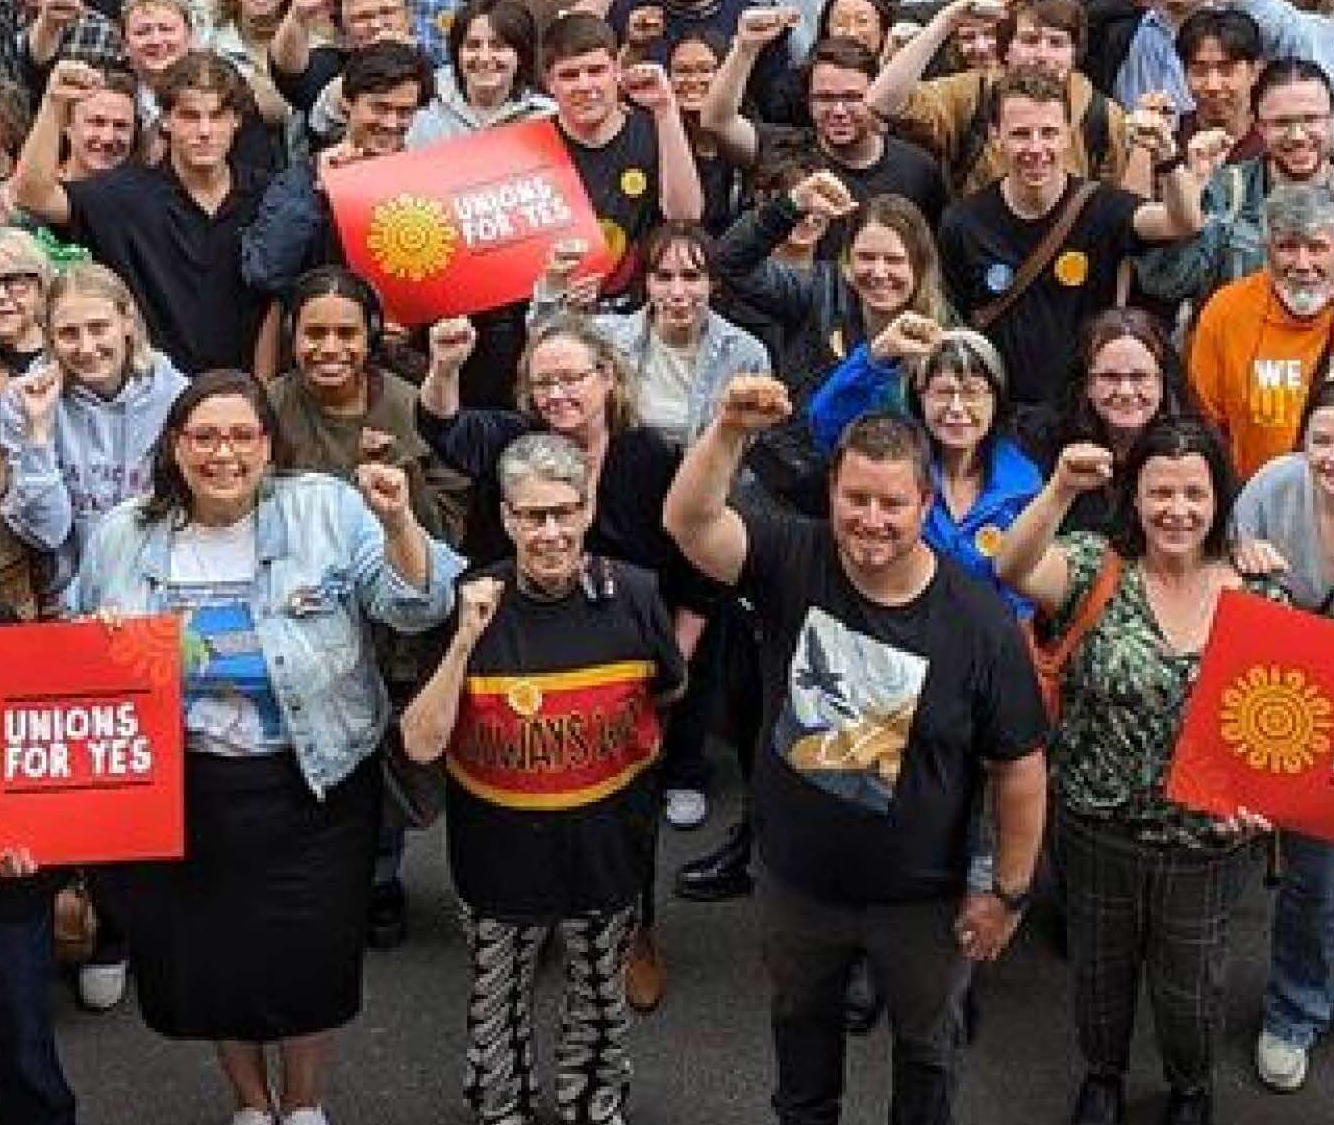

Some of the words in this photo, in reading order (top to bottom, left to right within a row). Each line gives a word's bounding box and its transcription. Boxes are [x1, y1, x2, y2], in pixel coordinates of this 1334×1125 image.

[453, 176, 554, 219] UNIONS
[462, 215, 514, 245] FOR
[526, 197, 572, 228] YES
[3, 701, 139, 741] UNIONS
[3, 741, 73, 782] FOR
[86, 735, 152, 775] YES
